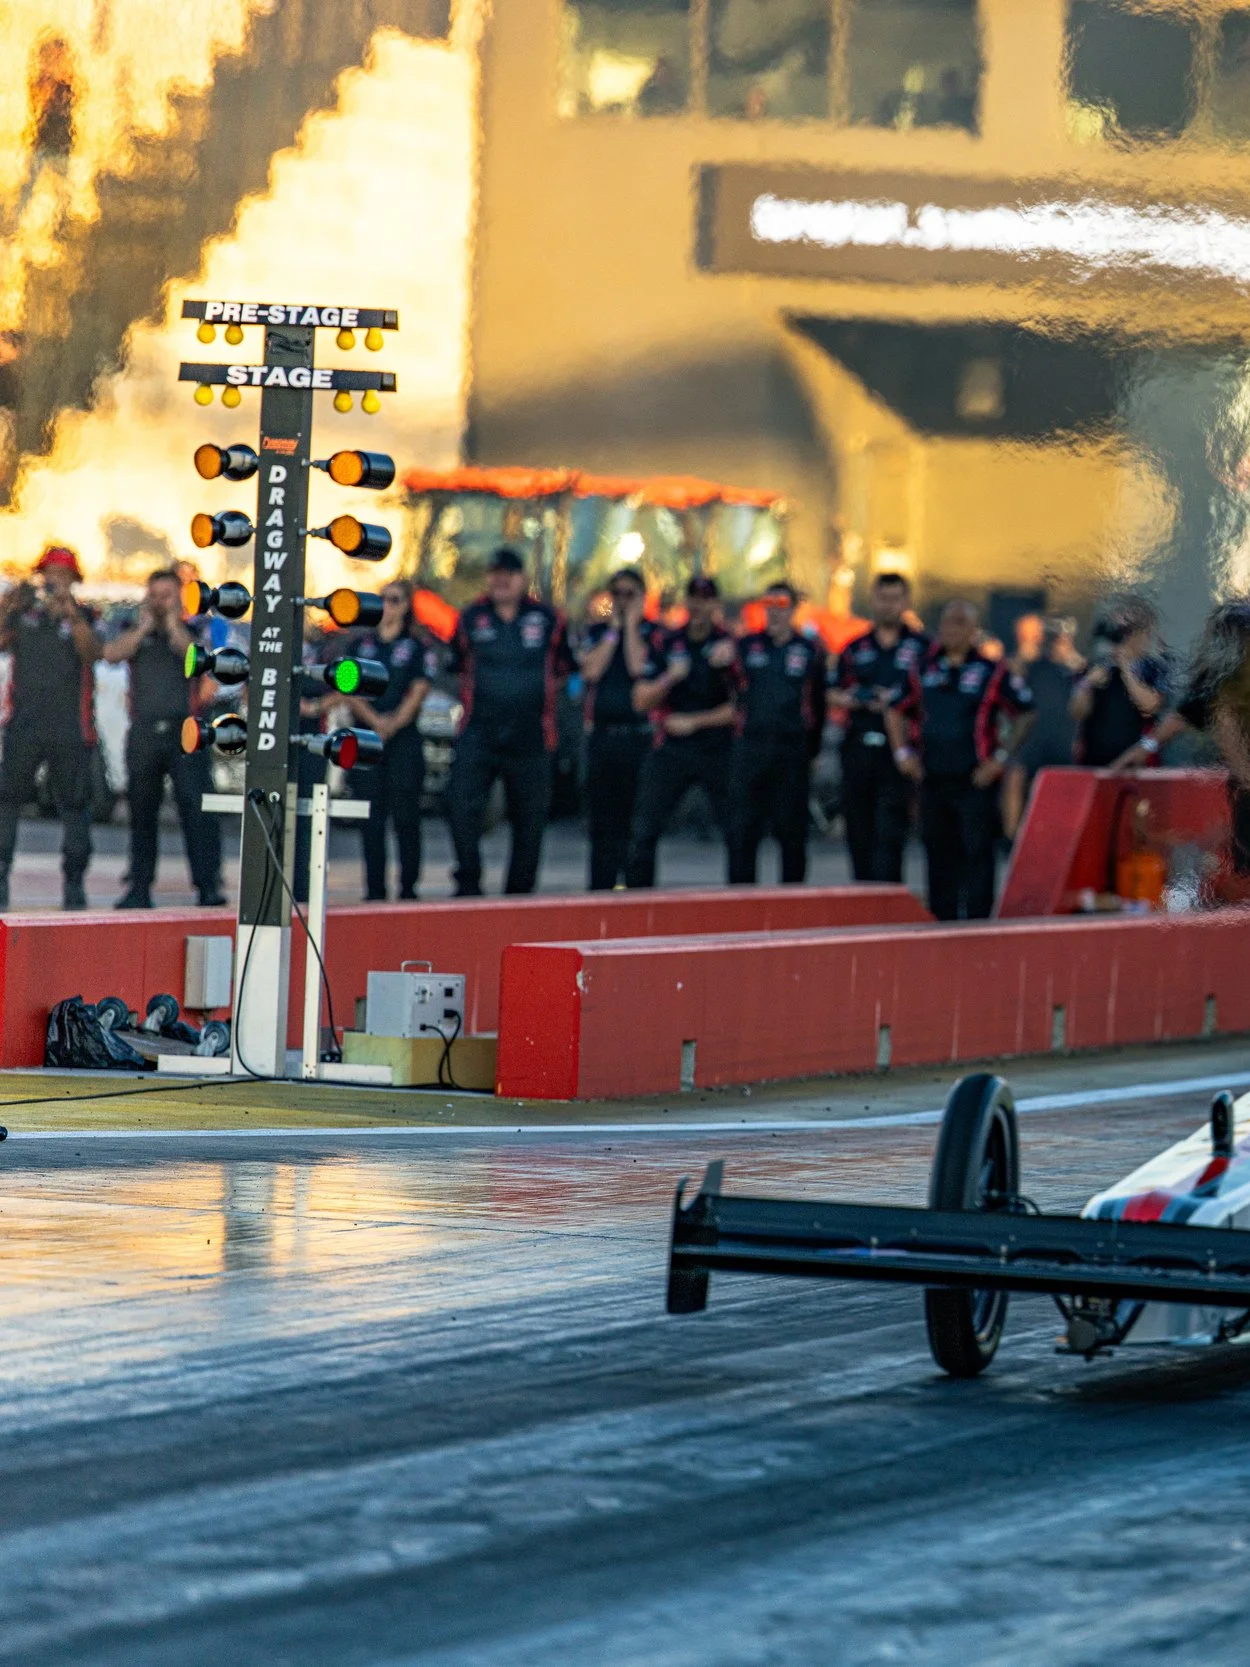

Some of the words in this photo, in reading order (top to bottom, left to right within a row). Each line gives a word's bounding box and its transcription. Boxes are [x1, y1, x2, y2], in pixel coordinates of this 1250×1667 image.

[204, 302, 359, 327] PRE-STAGE
[226, 365, 334, 389] STAGE
[262, 465, 288, 613] DRAGWAY
[262, 627, 281, 639] AT
[258, 641, 284, 653] THE
[257, 668, 278, 750] BEND
